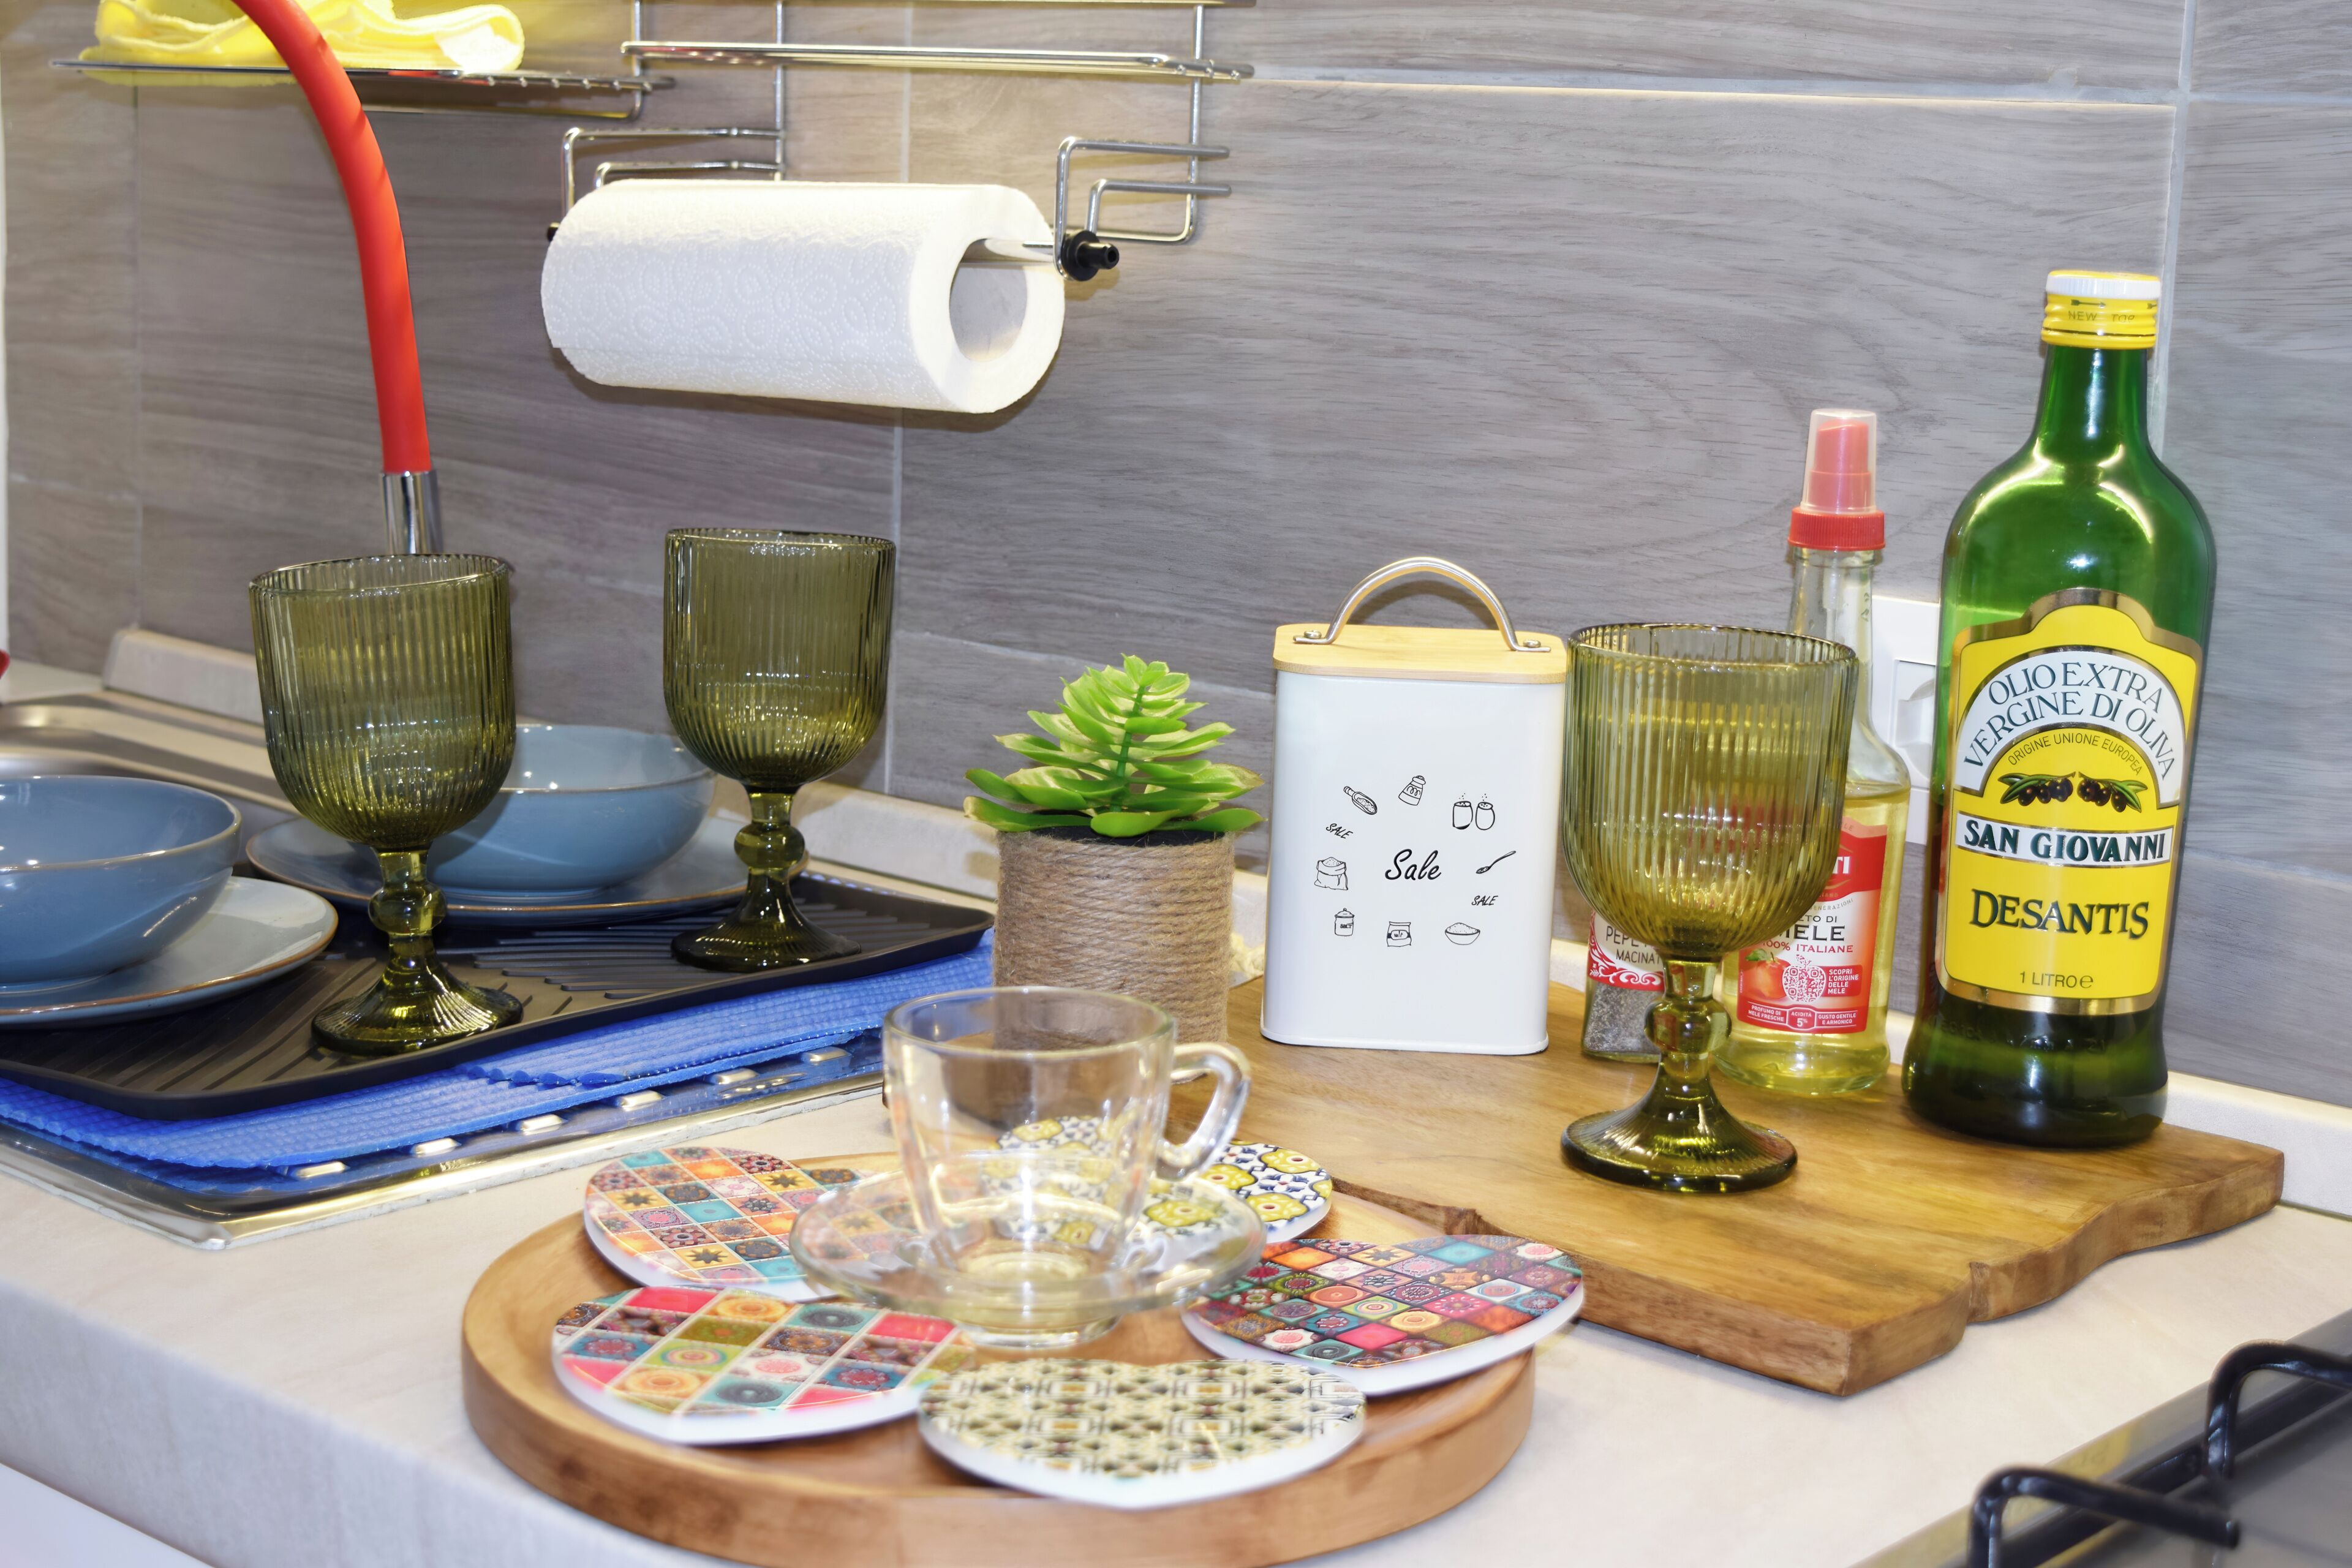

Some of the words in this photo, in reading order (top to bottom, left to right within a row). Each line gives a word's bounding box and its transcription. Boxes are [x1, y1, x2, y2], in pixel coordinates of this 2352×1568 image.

[2068, 311, 2097, 321] NEW
[2111, 313, 2135, 323] TOP
[1989, 665, 2056, 704] OLIO
[2062, 662, 2163, 714] EXTRA
[1964, 692, 2083, 767] VERGINE
[2090, 693, 2123, 722] DI
[2125, 708, 2175, 780] OLIVA
[2008, 736, 2051, 765] ORIGINE
[2054, 733, 2100, 745] UNIONE
[2101, 738, 2143, 775] EUROPEA
[1325, 823, 1354, 839] SALE
[1964, 820, 2020, 854] SAN
[2030, 832, 2166, 862] GIOVANNI
[1385, 848, 1442, 881] Sale
[1471, 895, 1498, 907] SALE
[1969, 888, 2149, 940] DESANTIS
[1763, 940, 1791, 951] 00%
[1796, 944, 1853, 953] ITALIANE
[2019, 971, 2026, 983] 1
[1751, 1005, 1774, 1014] PROFUMO
[1761, 1012, 1784, 1022] FRESCHE
